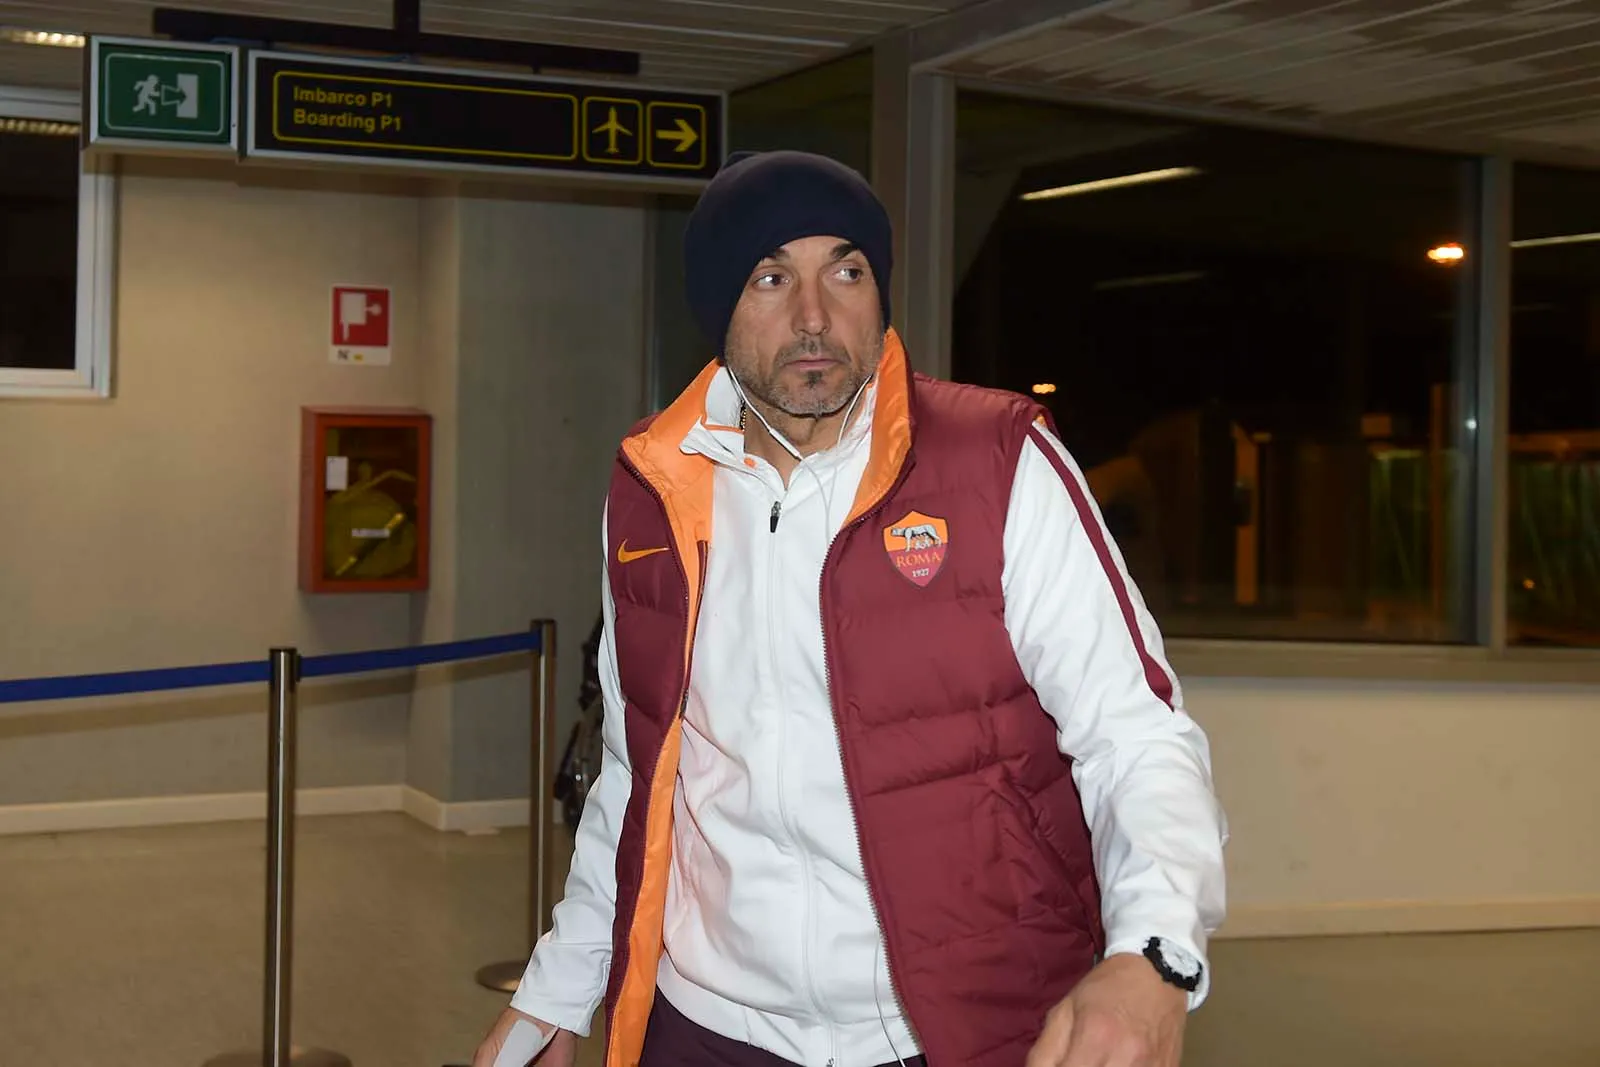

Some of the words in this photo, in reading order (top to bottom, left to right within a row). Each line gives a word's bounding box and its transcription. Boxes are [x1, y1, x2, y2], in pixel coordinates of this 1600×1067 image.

[294, 86, 367, 106] Imbarco
[371, 92, 392, 108] P1
[294, 108, 375, 133] Boarding
[381, 115, 401, 132] P1
[896, 552, 941, 567] ROMA
